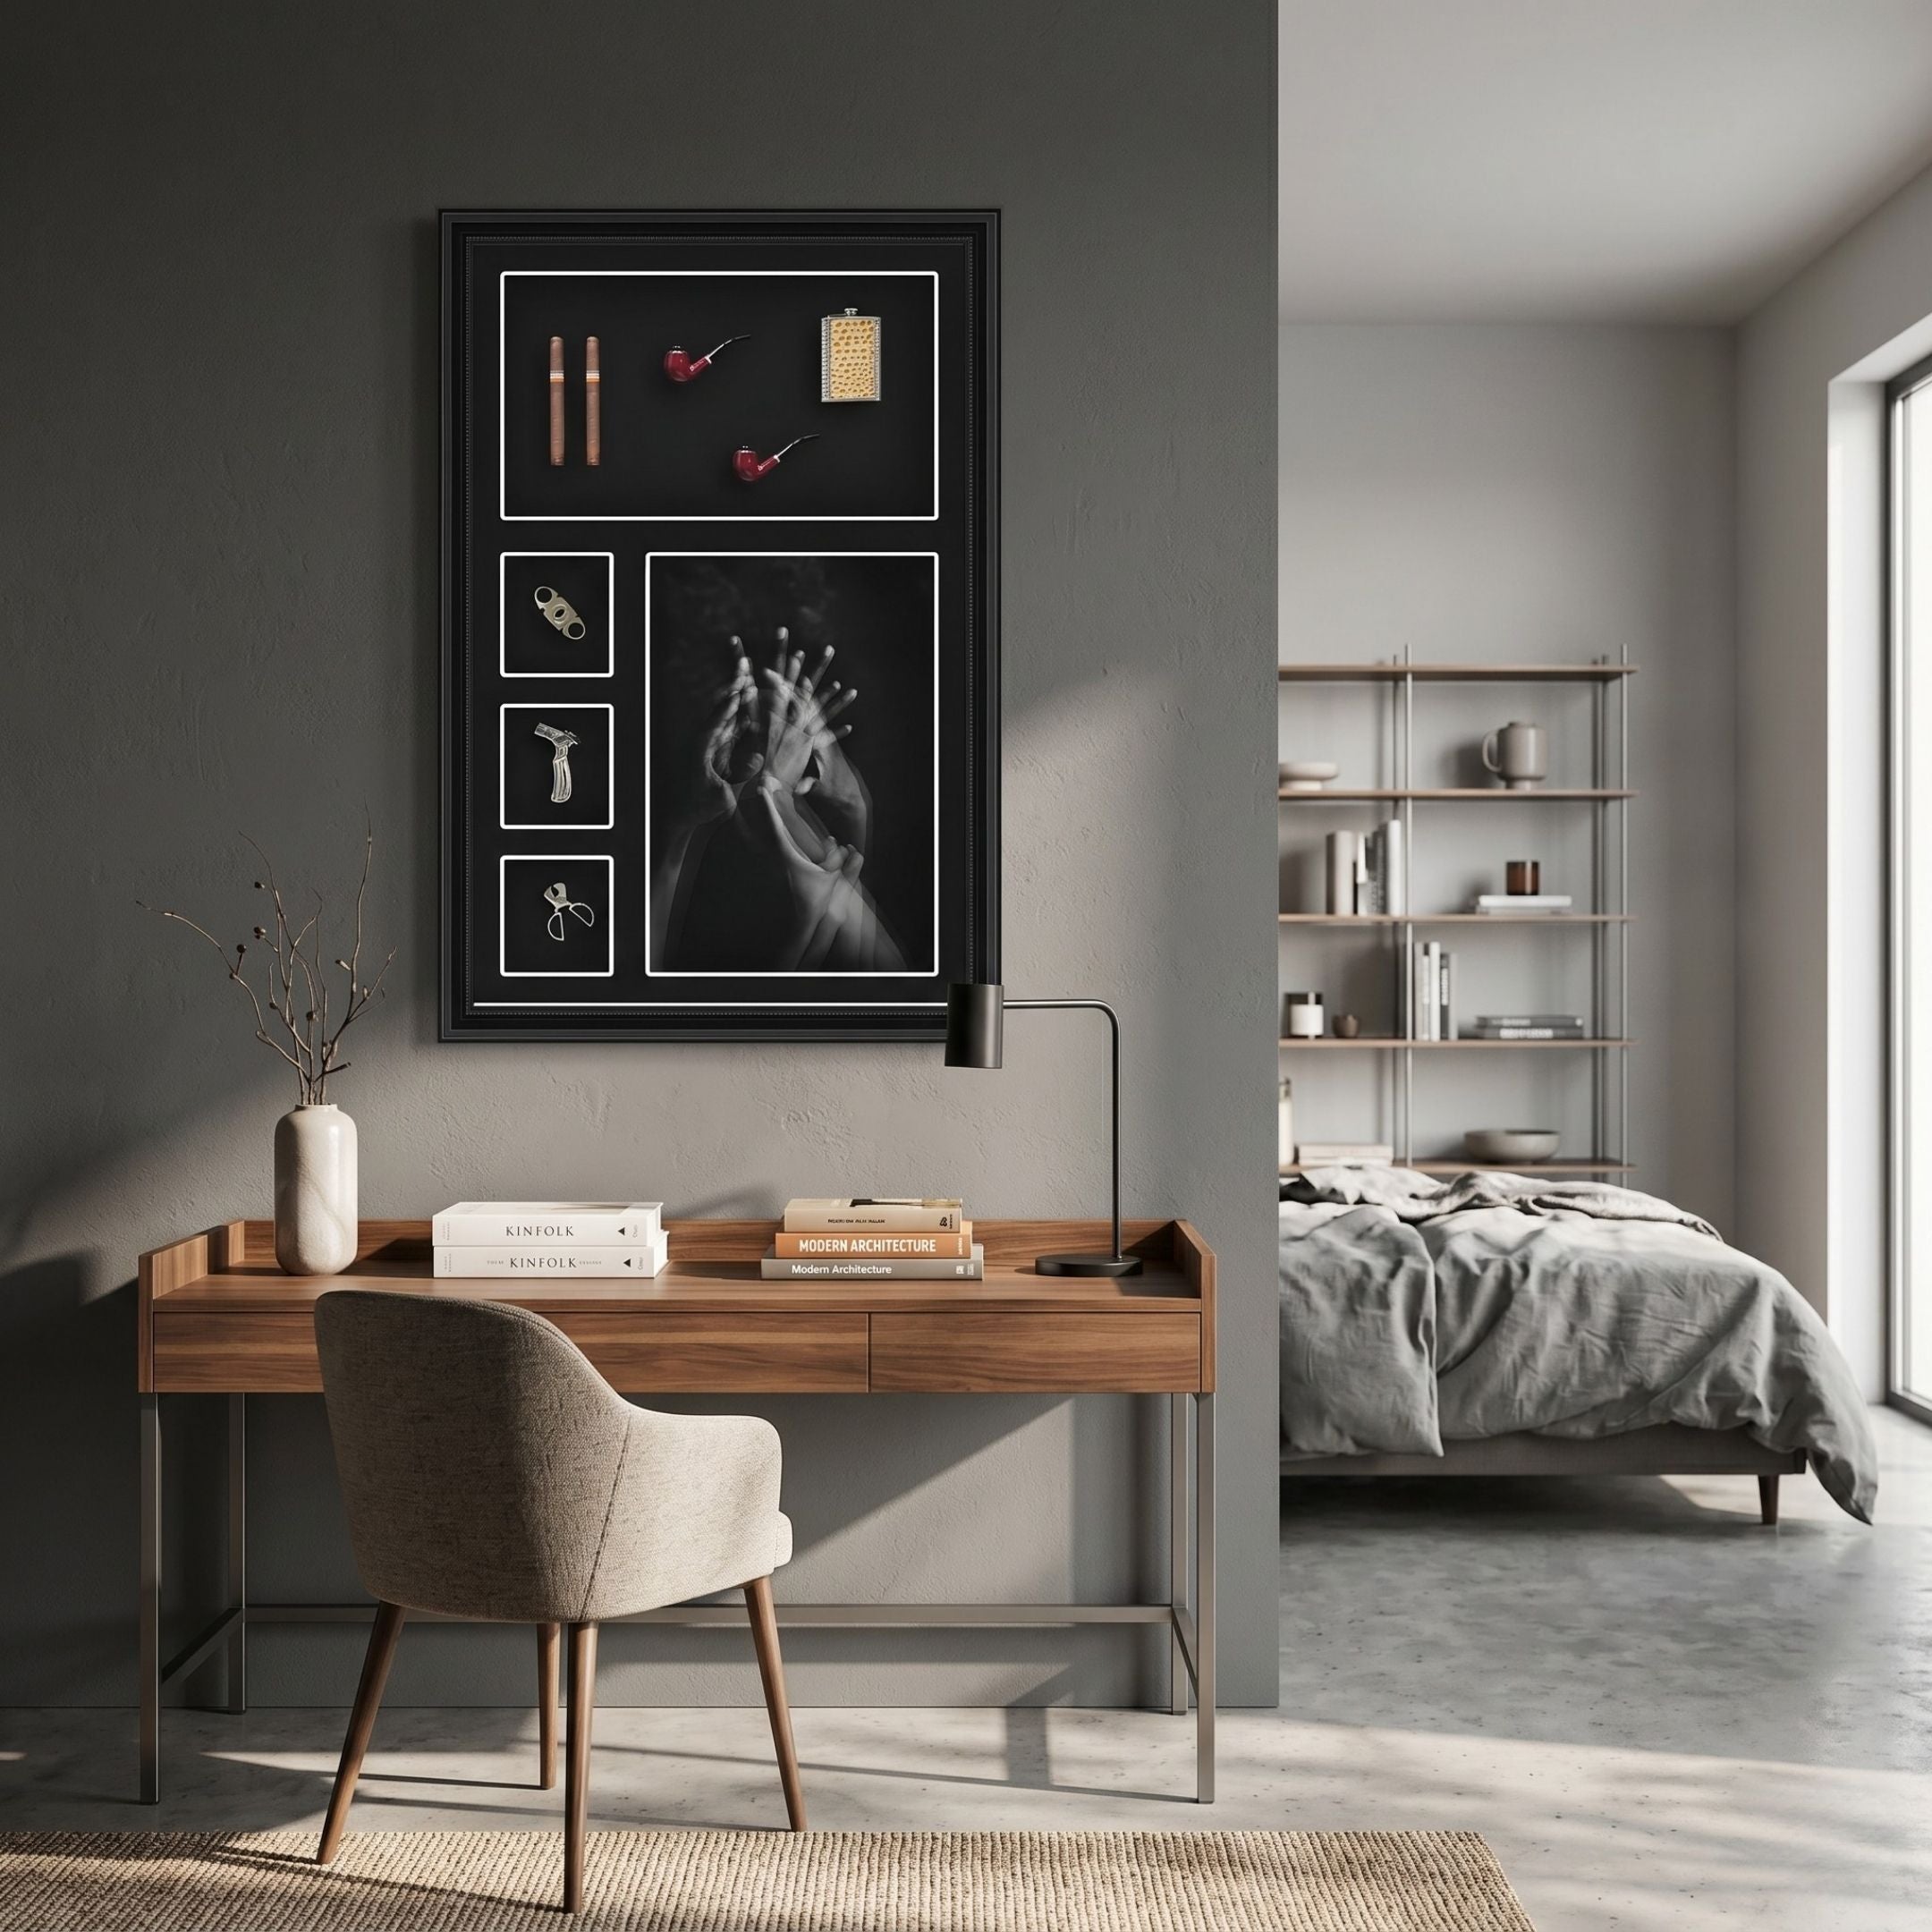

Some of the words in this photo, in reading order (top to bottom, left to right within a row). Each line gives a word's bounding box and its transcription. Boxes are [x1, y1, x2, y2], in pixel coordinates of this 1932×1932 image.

[505, 1225, 574, 1237] KINFOLK
[799, 1239, 848, 1252] MODERN
[850, 1239, 936, 1252] ARCHITECTURE
[510, 1257, 577, 1268] KINFOLK
[792, 1264, 830, 1275] Modern
[832, 1264, 893, 1275] Architecture
